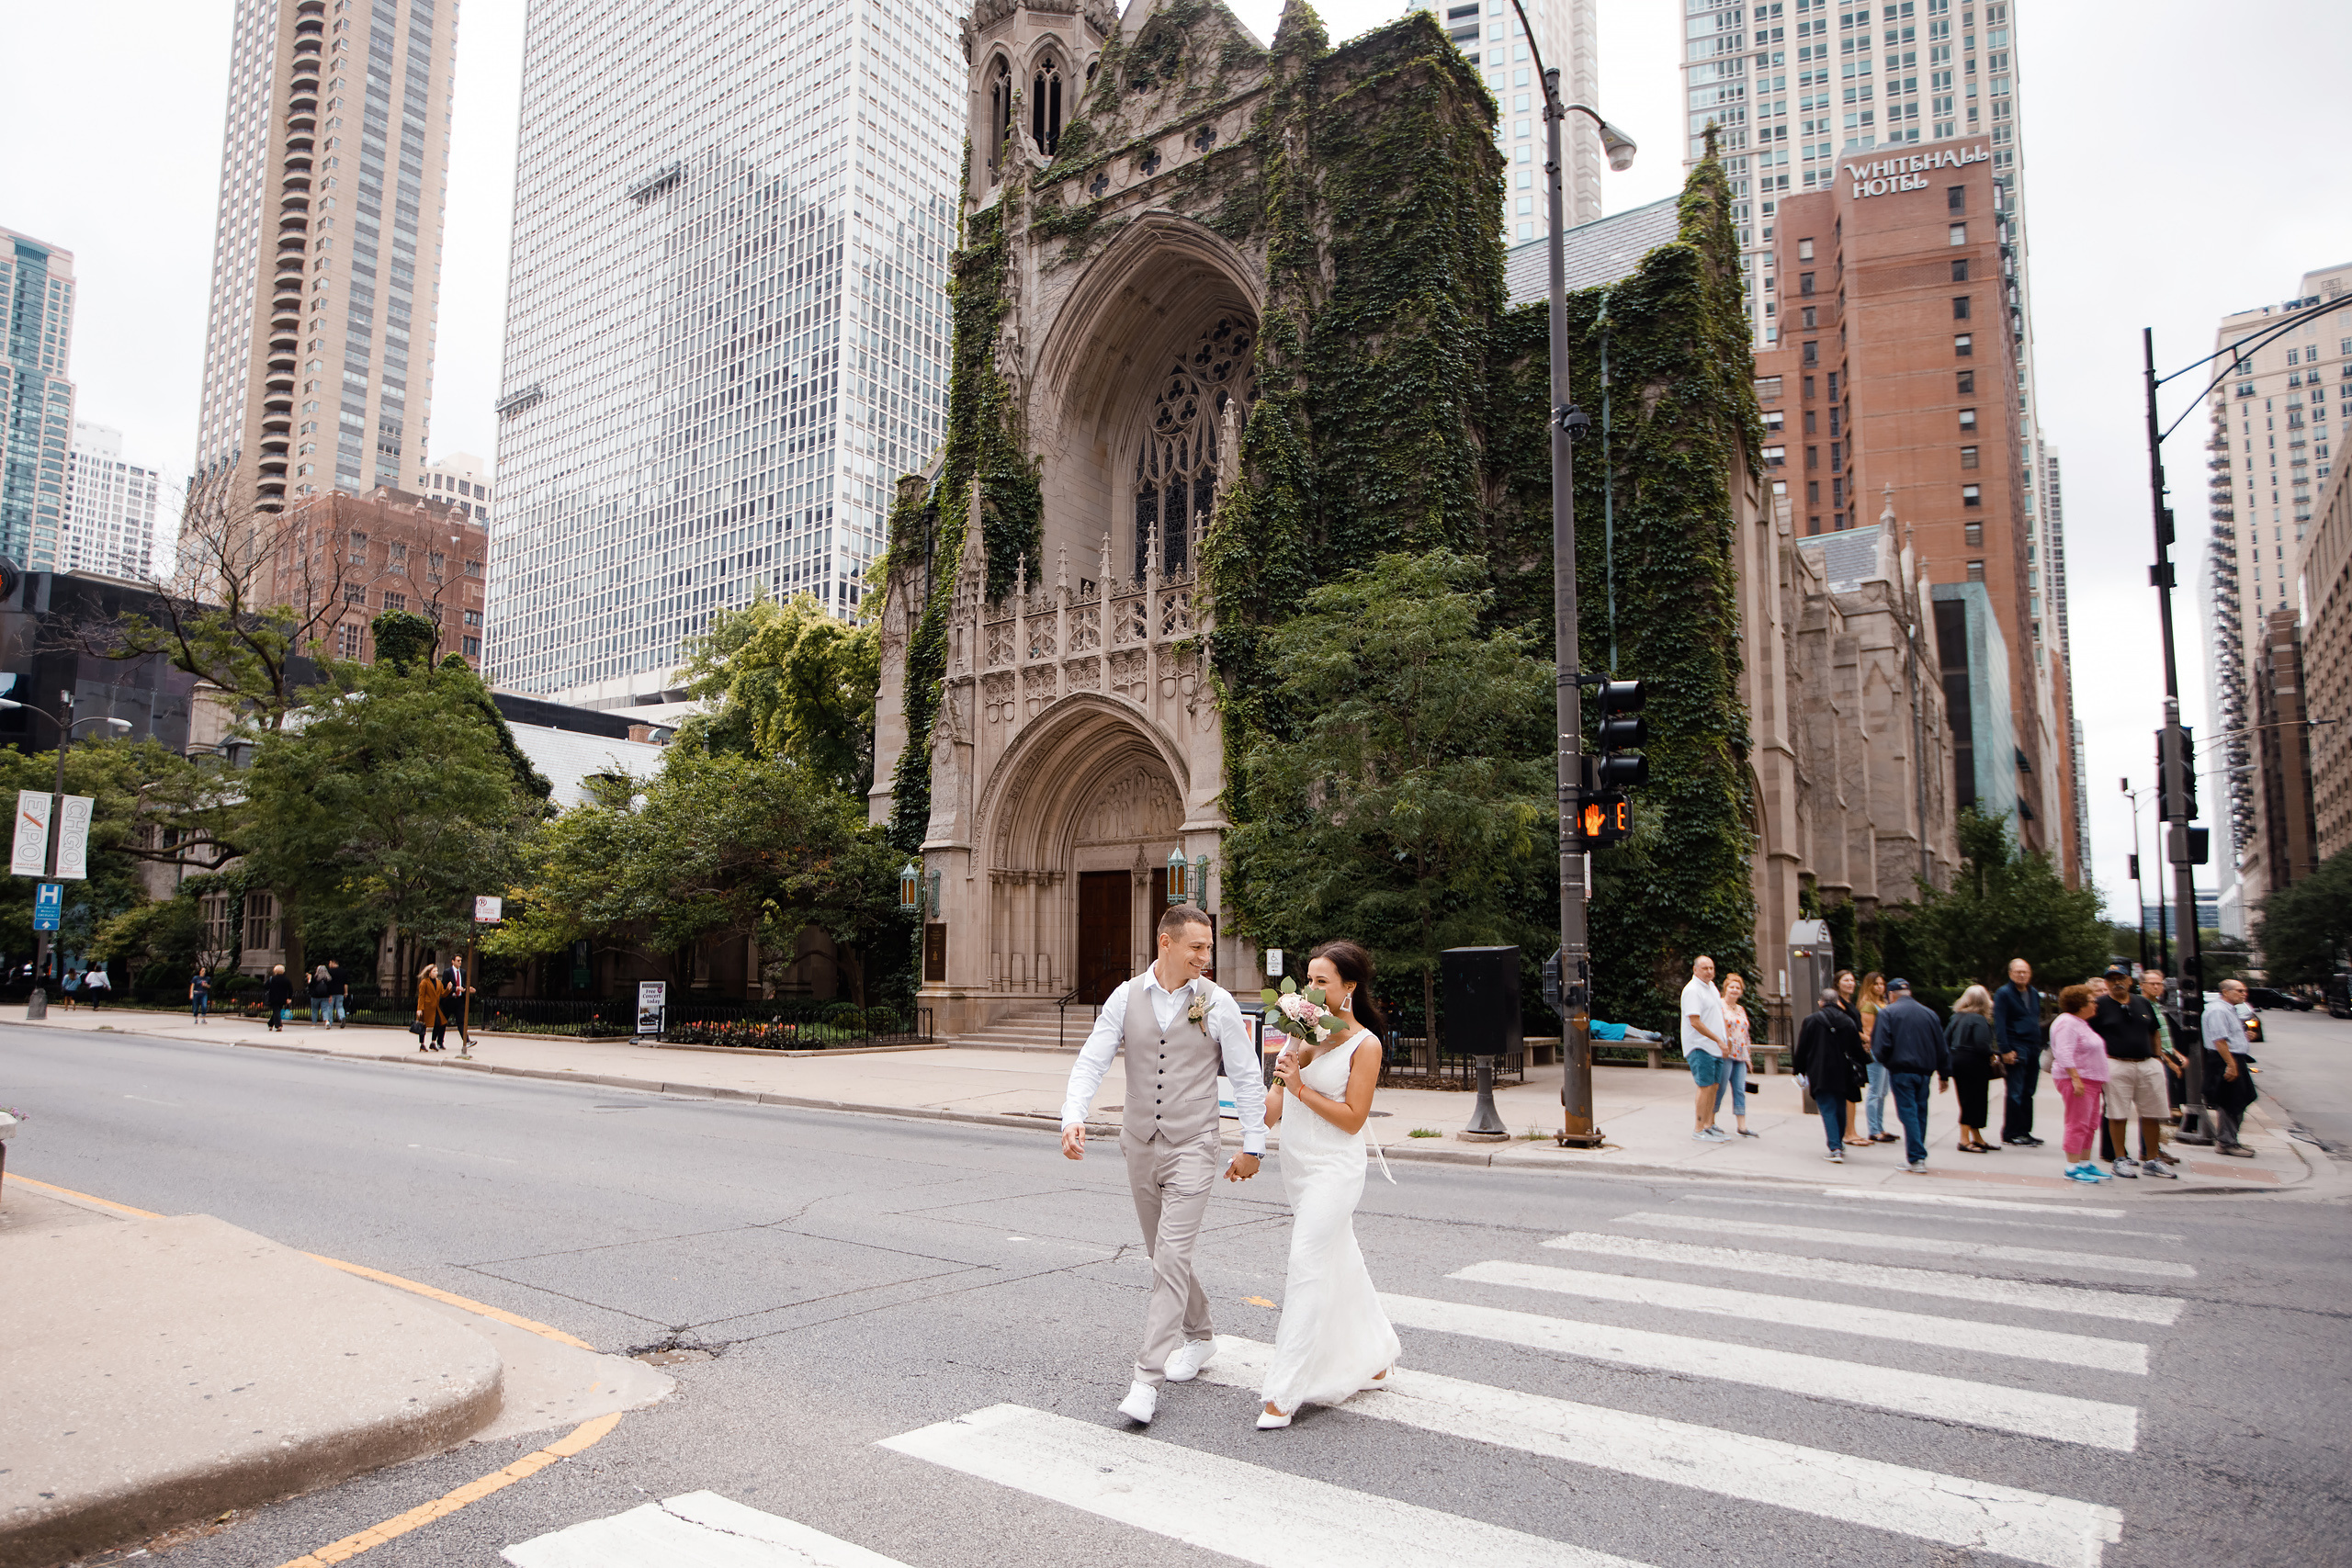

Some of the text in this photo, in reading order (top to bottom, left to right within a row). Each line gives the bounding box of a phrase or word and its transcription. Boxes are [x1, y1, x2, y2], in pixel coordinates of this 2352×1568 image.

[1844, 145, 1989, 180] WHITEHALL
[1853, 173, 1928, 199] HOTEL
[18, 795, 47, 862] EXPO
[62, 801, 87, 866] CHGO
[40, 885, 59, 904] H
